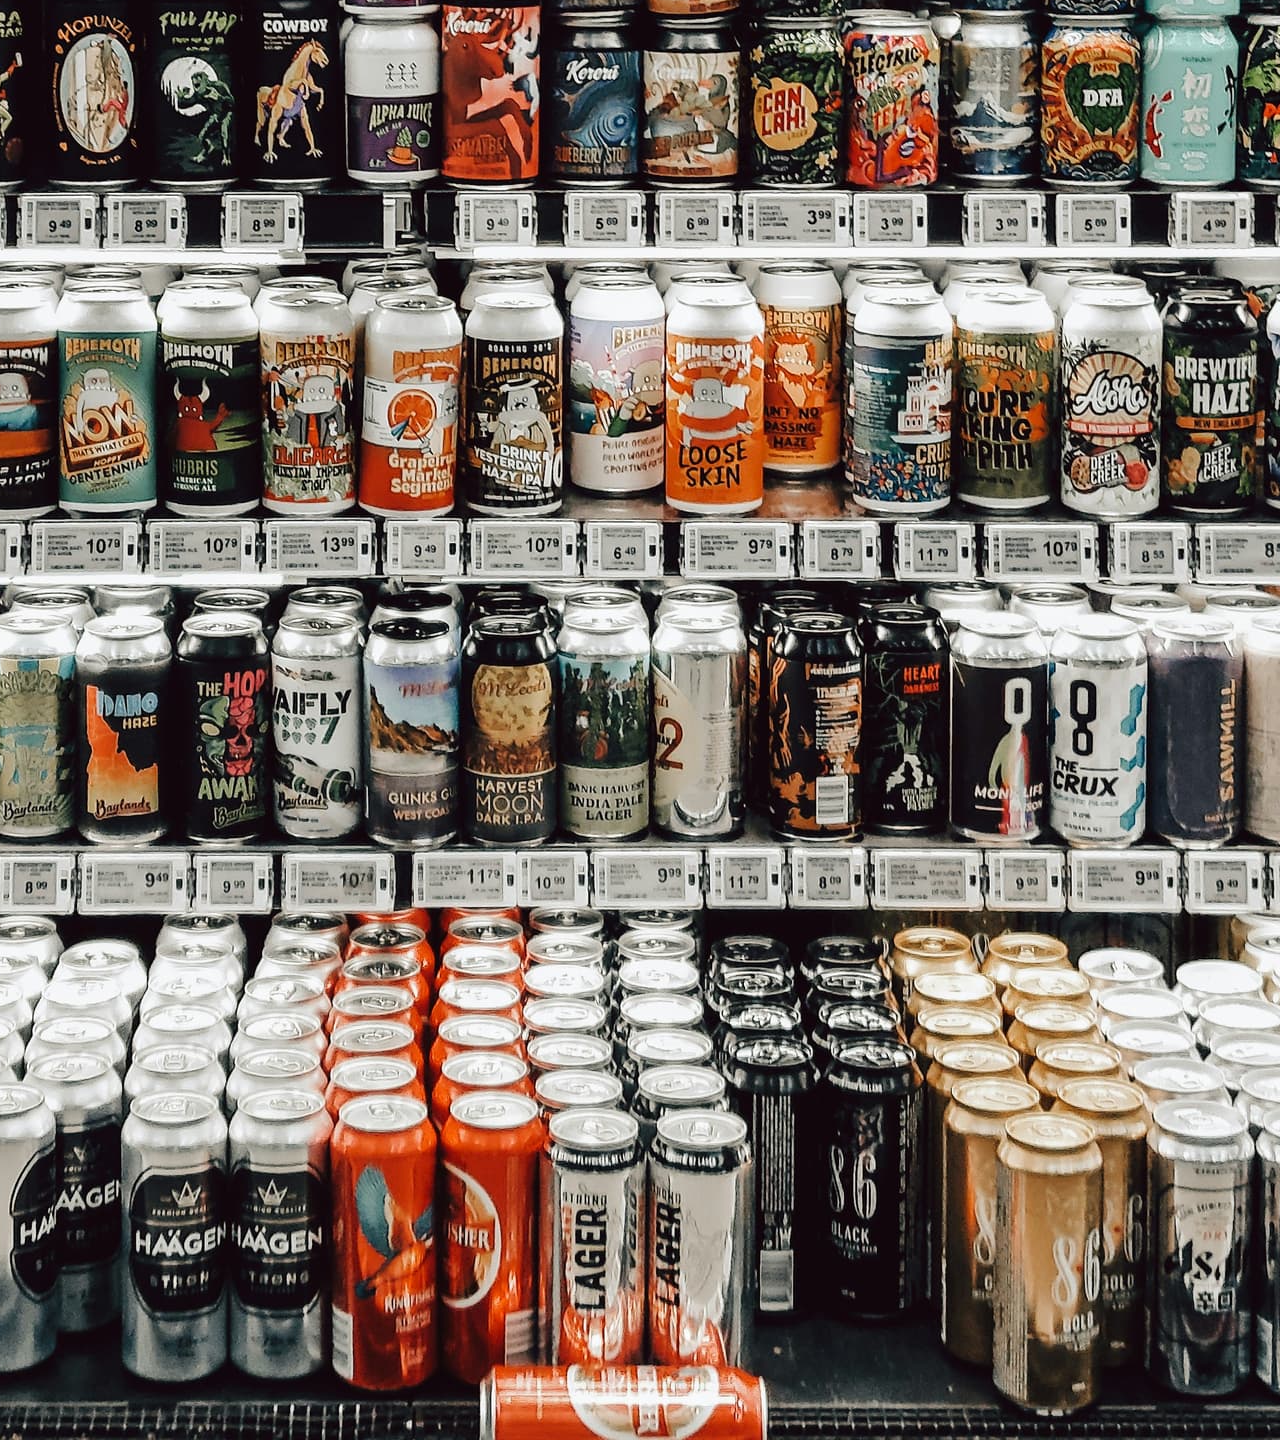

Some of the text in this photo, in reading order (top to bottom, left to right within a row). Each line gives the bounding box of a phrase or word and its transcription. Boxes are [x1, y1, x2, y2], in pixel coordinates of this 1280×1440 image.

[57, 15, 134, 47] HOPUNZEL
[160, 12, 238, 34] FULL HOP
[263, 19, 329, 33] COWBOY
[762, 91, 804, 115] CAN
[1082, 89, 1125, 109] DFA
[65, 338, 141, 359] BEHEMOTH
[163, 344, 234, 365] BEHEMOTH
[1073, 372, 1149, 414] Aloha
[1193, 382, 1251, 415] HAZE
[61, 401, 134, 448] NOW
[500, 445, 543, 460] DRINK
[679, 441, 748, 470] LOOSE
[1091, 456, 1120, 471] DEEP
[70, 460, 148, 484] CENTENNIAL
[173, 460, 218, 477] HUBRIS
[687, 465, 741, 489] SKIN
[1092, 467, 1125, 485] CREEK
[197, 670, 265, 698] THE HOP
[96, 690, 159, 717] IDAHO
[476, 779, 544, 794] HARVEST
[1054, 772, 1119, 798] CRUX
[387, 789, 440, 805] GLINKS
[476, 795, 545, 812] MOON
[2, 801, 58, 820] Baylands
[477, 813, 511, 825] DARK
[586, 809, 633, 822] LAGER
[136, 1227, 226, 1256] HAÄGEN
[231, 1224, 322, 1256] HAÄGEN
[573, 1205, 607, 1312] LAGER
